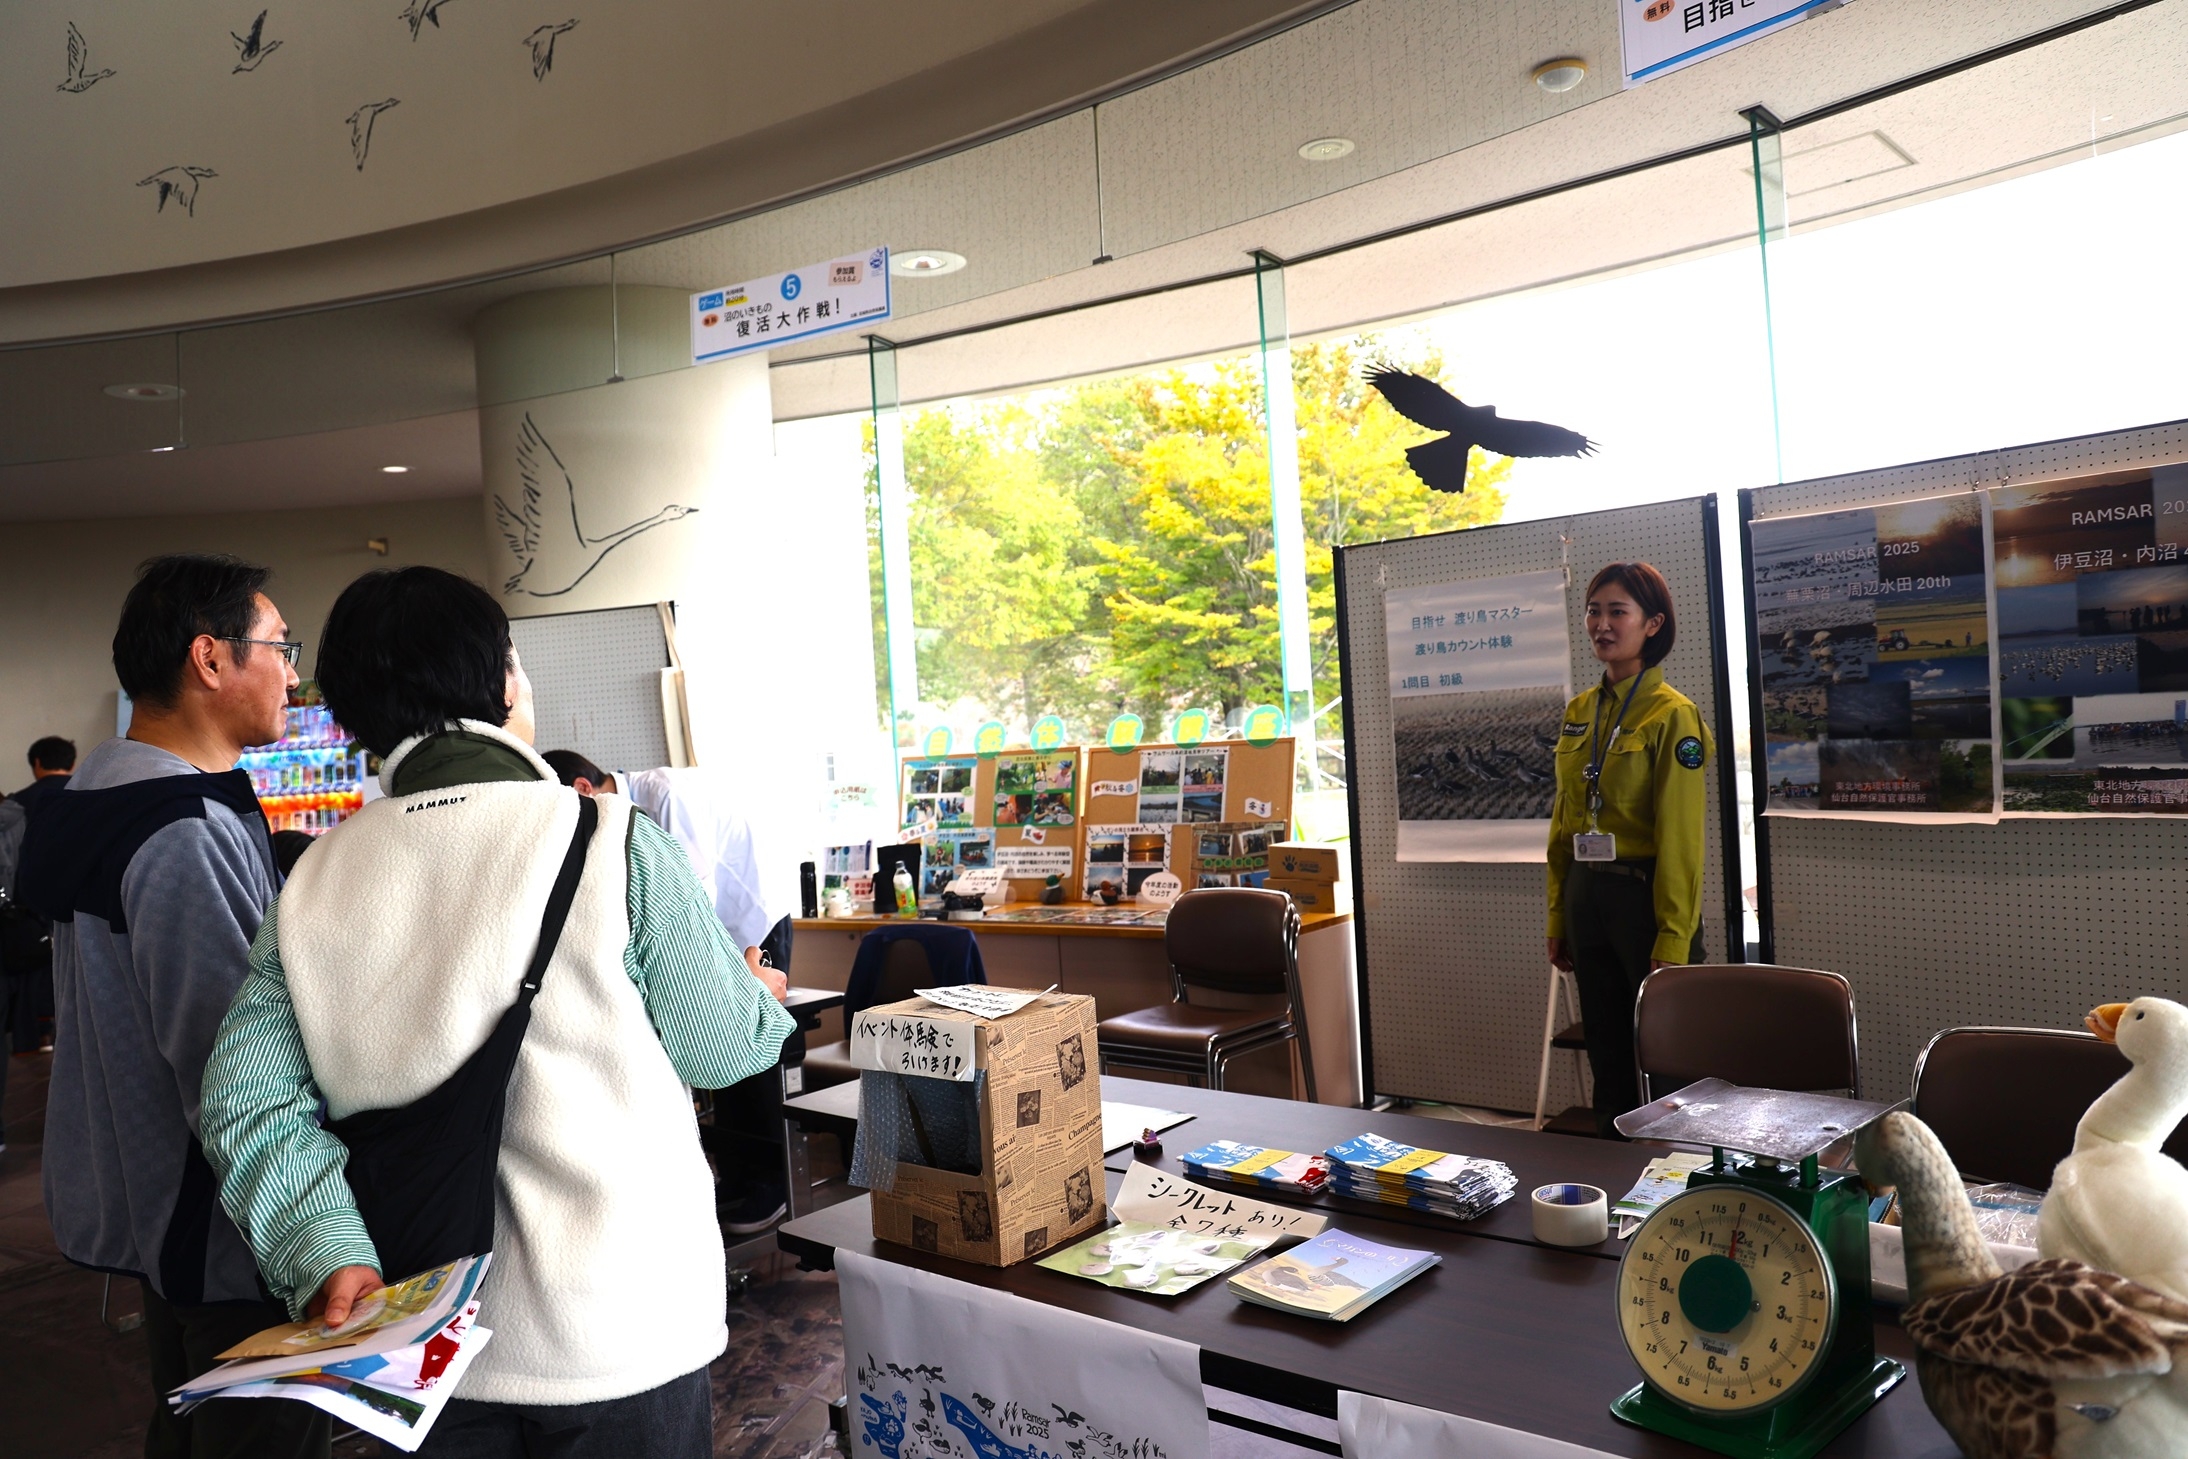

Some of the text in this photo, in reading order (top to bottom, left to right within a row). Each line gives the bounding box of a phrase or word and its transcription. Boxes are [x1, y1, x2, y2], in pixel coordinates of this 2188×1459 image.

[1647, 1, 1671, 20] 無料
[786, 277, 796, 297] 5
[700, 296, 722, 309] ゲーム
[724, 303, 772, 322] 沼のいきもの
[2071, 500, 2188, 525] RAMSAR 20
[1814, 541, 1920, 564] RAMSAR 2025
[2053, 542, 2177, 571] 伊豆沼・内沼
[1917, 575, 1951, 590] 20th
[1411, 605, 1533, 630] 目指せ 渡り鳥マスター
[1415, 635, 1513, 655] 渡り鳥カウント体験
[1401, 672, 1463, 689] 1問目 初級
[1565, 723, 1588, 733] Ranger
[405, 797, 466, 813] MAMMUT
[1145, 881, 1178, 889] 今年度の活動
[1149, 889, 1170, 898] のようす
[901, 1052, 962, 1077] 引けます!
[1147, 1177, 1302, 1230] シークレット あり!
[1712, 1204, 1727, 1214] 11.5
[1739, 1202, 1746, 1213] 0
[1669, 1217, 1684, 1228] 10.5
[1700, 1230, 1714, 1246] 11
[1675, 1247, 1690, 1262] 10
[1763, 1244, 1769, 1257] 1
[1794, 1243, 1806, 1253] 1.5
[1642, 1252, 1654, 1261] 9.5
[1781, 1271, 1792, 1286] 2
[1633, 1296, 1644, 1306] 8.5
[1810, 1289, 1825, 1300] 2.5
[1661, 1311, 1670, 1324] 8
[1646, 1342, 1658, 1354] 7.5
[1679, 1340, 1688, 1354] 7
[1702, 1342, 1729, 1356] Yamato
[1769, 1338, 1778, 1353] 4
[1801, 1339, 1816, 1351] 3.5
[1740, 1356, 1749, 1372] 5
[1677, 1375, 1690, 1387] 6.5
[1768, 1376, 1782, 1388] 4.5
[1723, 1388, 1737, 1400] 5.5
[1021, 1408, 1050, 1428] Ramsar
[1026, 1423, 1050, 1440] 2025
